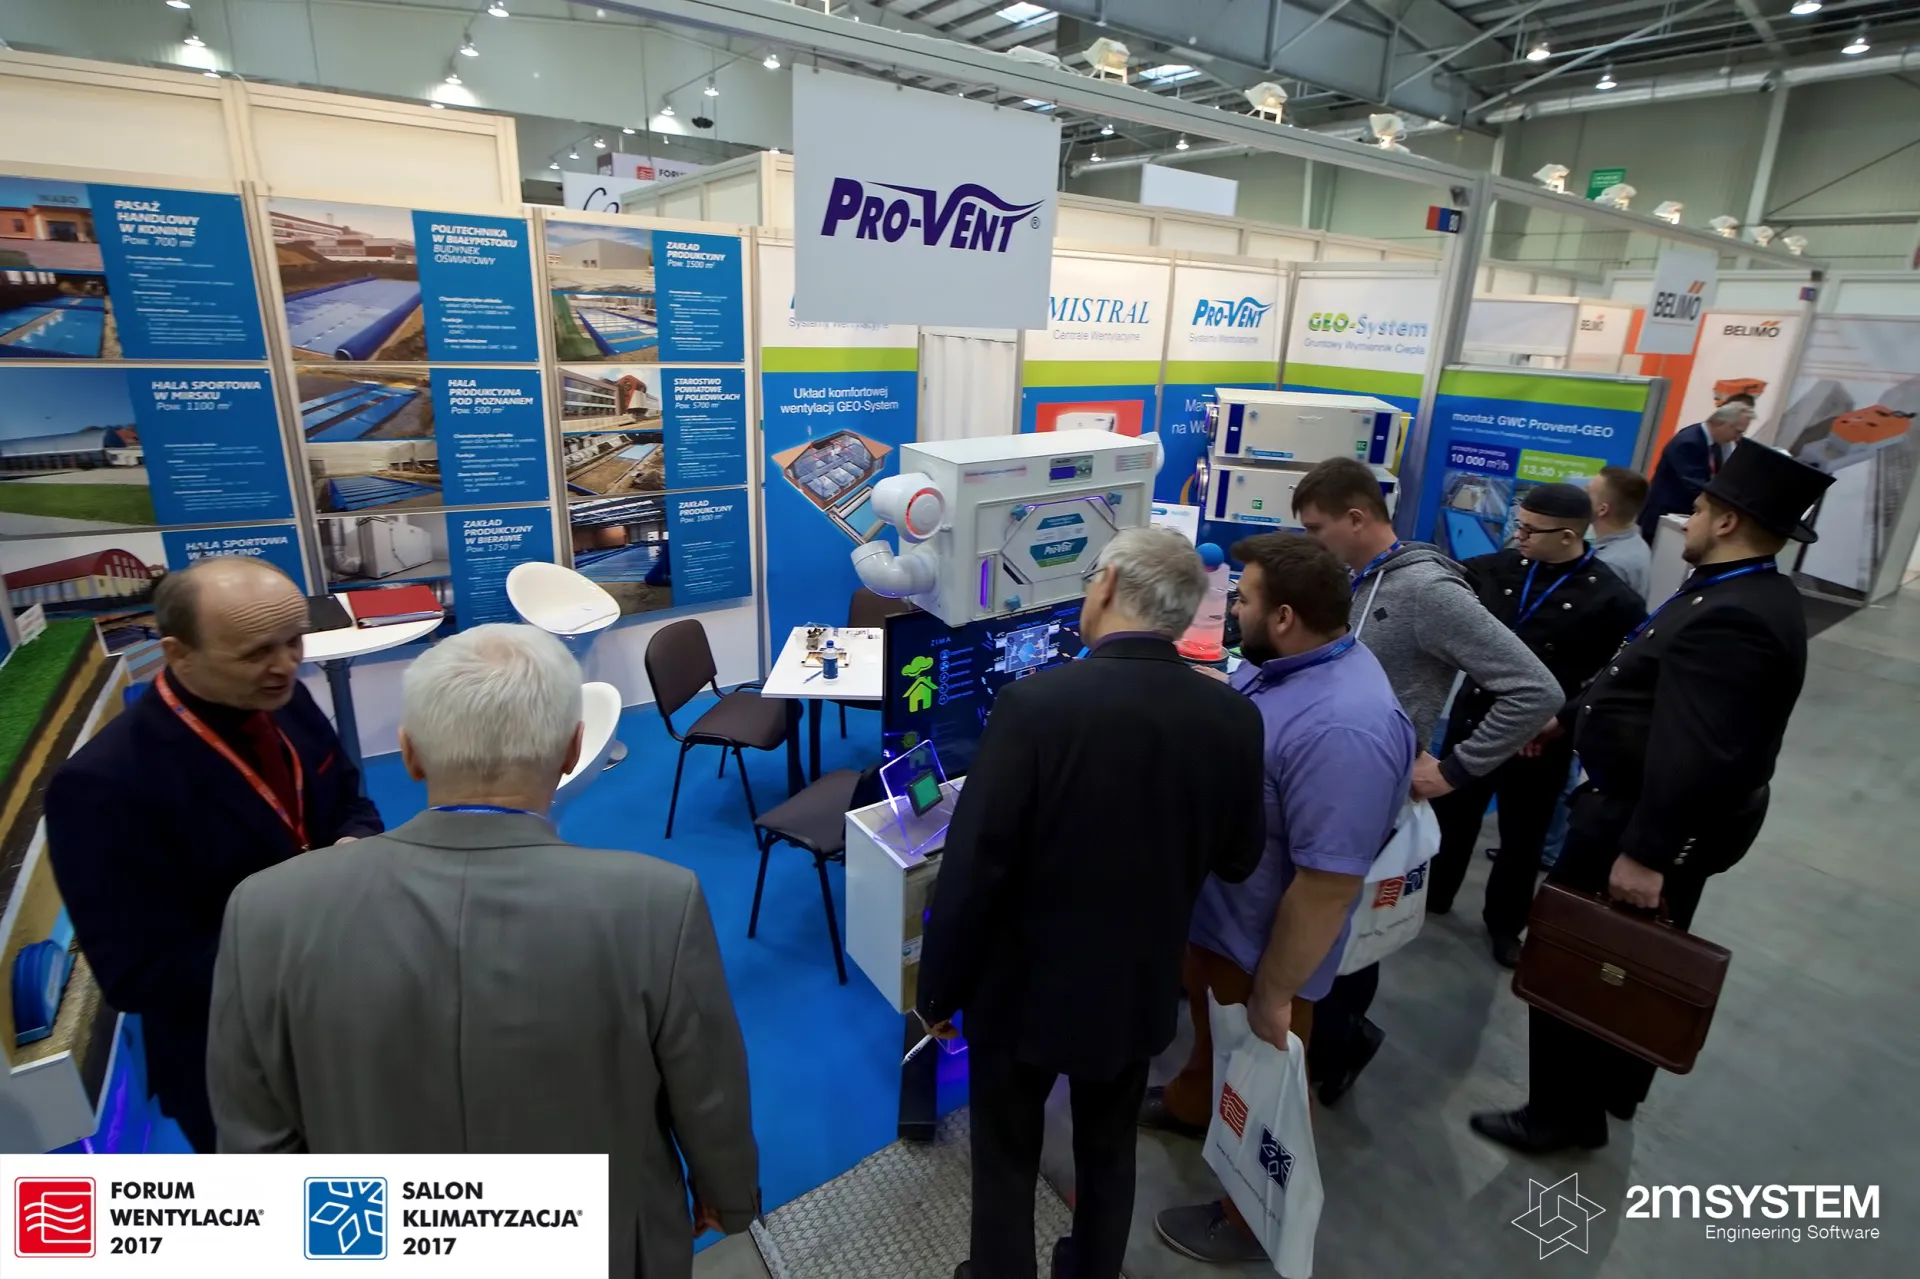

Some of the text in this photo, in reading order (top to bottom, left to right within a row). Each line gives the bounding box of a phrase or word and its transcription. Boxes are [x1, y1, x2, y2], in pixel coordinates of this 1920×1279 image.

[114, 200, 160, 212] PASAŻ
[117, 212, 200, 226] HANDLOWY
[119, 223, 196, 237] W KONINIE
[430, 224, 508, 237] POLITECHNIKA
[432, 234, 445, 243] W
[433, 244, 480, 255] BUDYNEK
[666, 250, 726, 261] PRODUKCYJNY
[1049, 296, 1150, 324] MISTRAL
[1653, 291, 1703, 321] BELIMO
[1308, 312, 1428, 340] GEO-System
[1723, 325, 1780, 338] BELIMO
[151, 381, 262, 390] HALA SPORTOWA
[447, 379, 477, 387] HALA
[154, 391, 221, 400] W MIRSKU
[449, 388, 522, 396] PRODUKCYJNA
[793, 386, 889, 399] Układ komfortowej
[186, 402, 215, 410] 1100
[450, 397, 534, 405] POD POZNANIEM
[474, 406, 491, 414] 500
[780, 400, 899, 415] wentylacji GEO-System
[1171, 423, 1187, 434] na
[1452, 413, 1495, 424] montaż
[1497, 415, 1527, 428] GWC
[1528, 418, 1614, 438] Provent-GEO
[1451, 453, 1465, 463] 10
[1465, 455, 1486, 467] 000
[679, 504, 733, 516] PRODUKCYJNY
[463, 519, 502, 528] ZAKŁAD
[464, 525, 533, 537] PRODUKCYJNY
[185, 536, 289, 551] HALA SPORTOWA
[465, 534, 522, 545] W BIERAWIE
[487, 543, 509, 552] 1750
